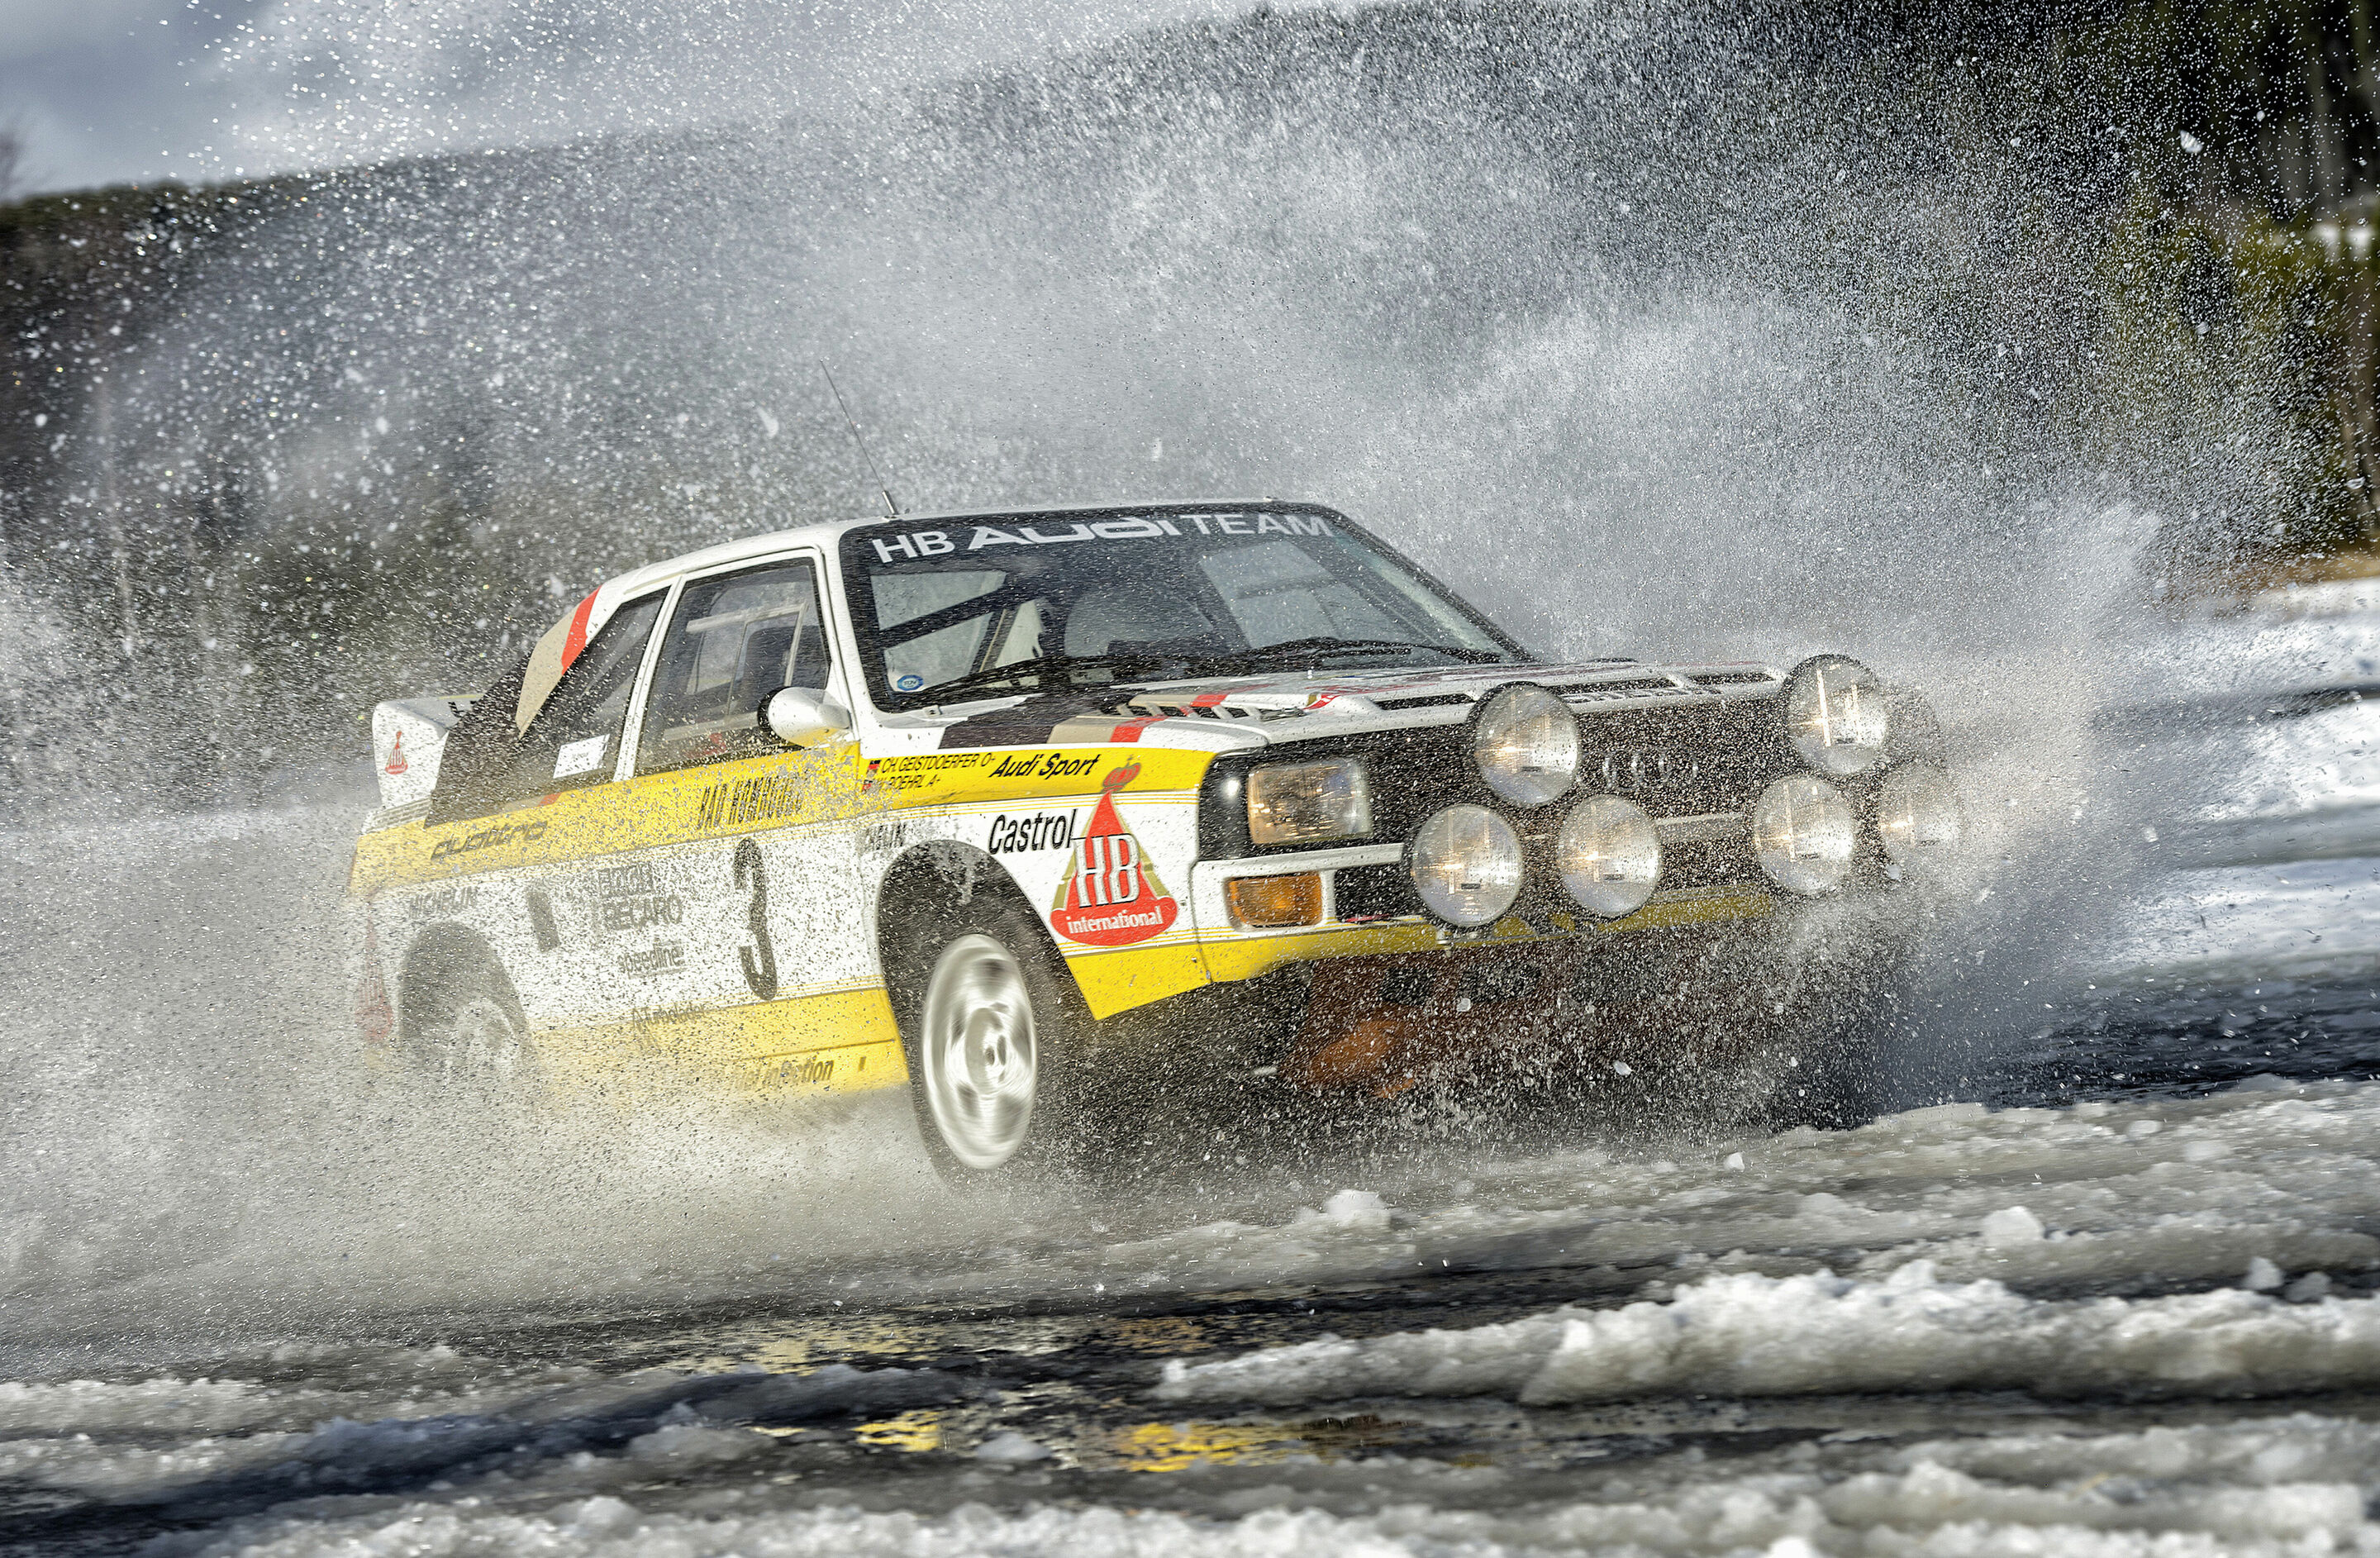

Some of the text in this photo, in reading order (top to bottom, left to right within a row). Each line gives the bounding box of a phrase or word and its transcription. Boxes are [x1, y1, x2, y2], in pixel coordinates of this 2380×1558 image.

[873, 531, 956, 564] HB
[1178, 512, 1333, 537] TEAM
[898, 753, 980, 771] GEISTDOERFER
[988, 753, 1101, 779] Audi Sport
[431, 821, 548, 862] quattro
[988, 808, 1078, 855] Castrol
[1072, 832, 1141, 908] HB
[602, 893, 683, 931] RECARO
[733, 837, 778, 1000] 3
[1066, 907, 1164, 934] international
[616, 940, 686, 978] speedline
